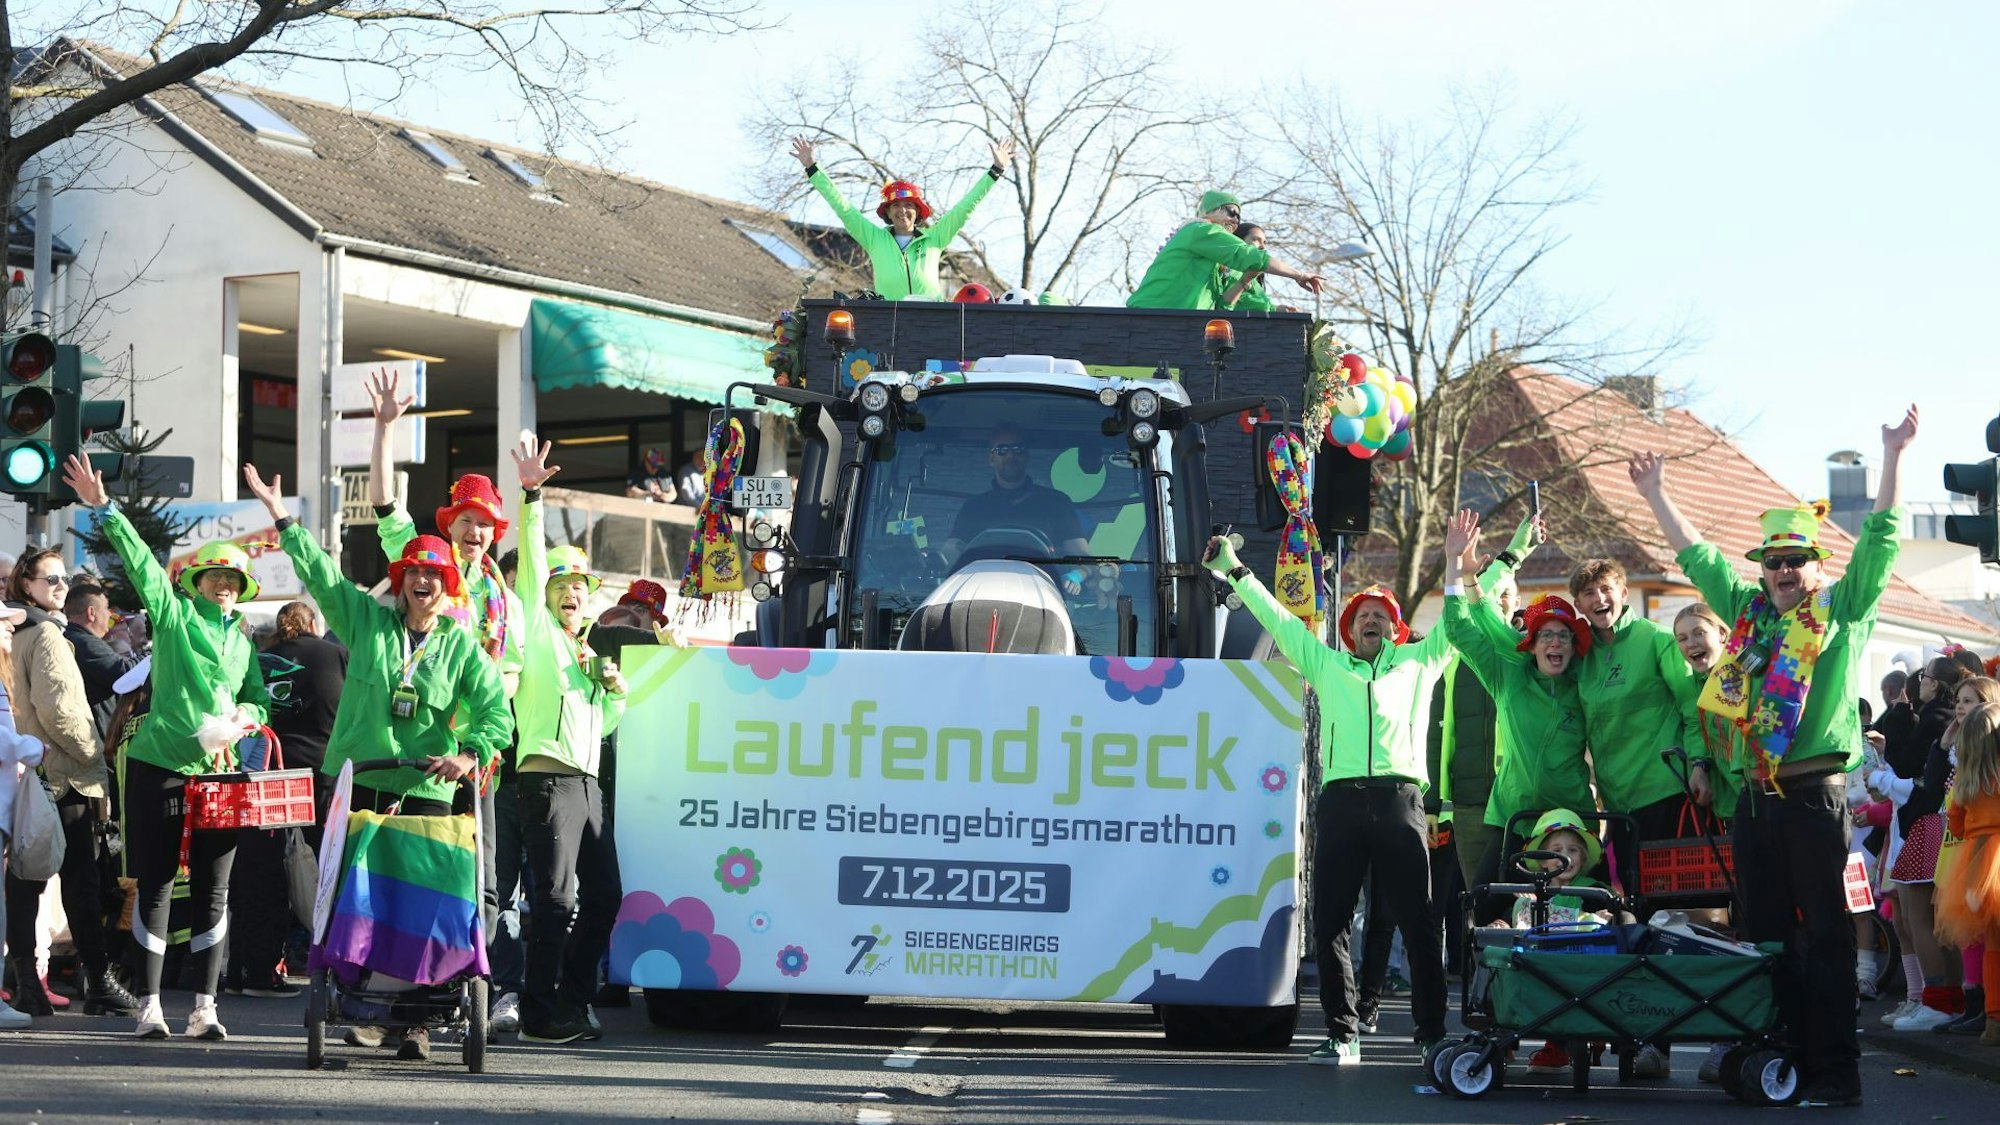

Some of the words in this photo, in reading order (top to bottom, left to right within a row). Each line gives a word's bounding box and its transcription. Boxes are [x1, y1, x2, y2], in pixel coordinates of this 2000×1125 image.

[742, 493, 751, 506] H
[756, 493, 783, 506] 113
[747, 479, 765, 492] SU
[686, 699, 1040, 784] Laufend
[1052, 711, 1239, 806] jeck
[679, 798, 719, 828] 25
[726, 799, 817, 831] Jahre
[825, 803, 1236, 847] Siebengebirgsmarathon
[862, 865, 1046, 904] 7.12.2025
[905, 931, 1059, 953] SIEBENGEBIRGS
[905, 951, 1058, 980] MARATHON
